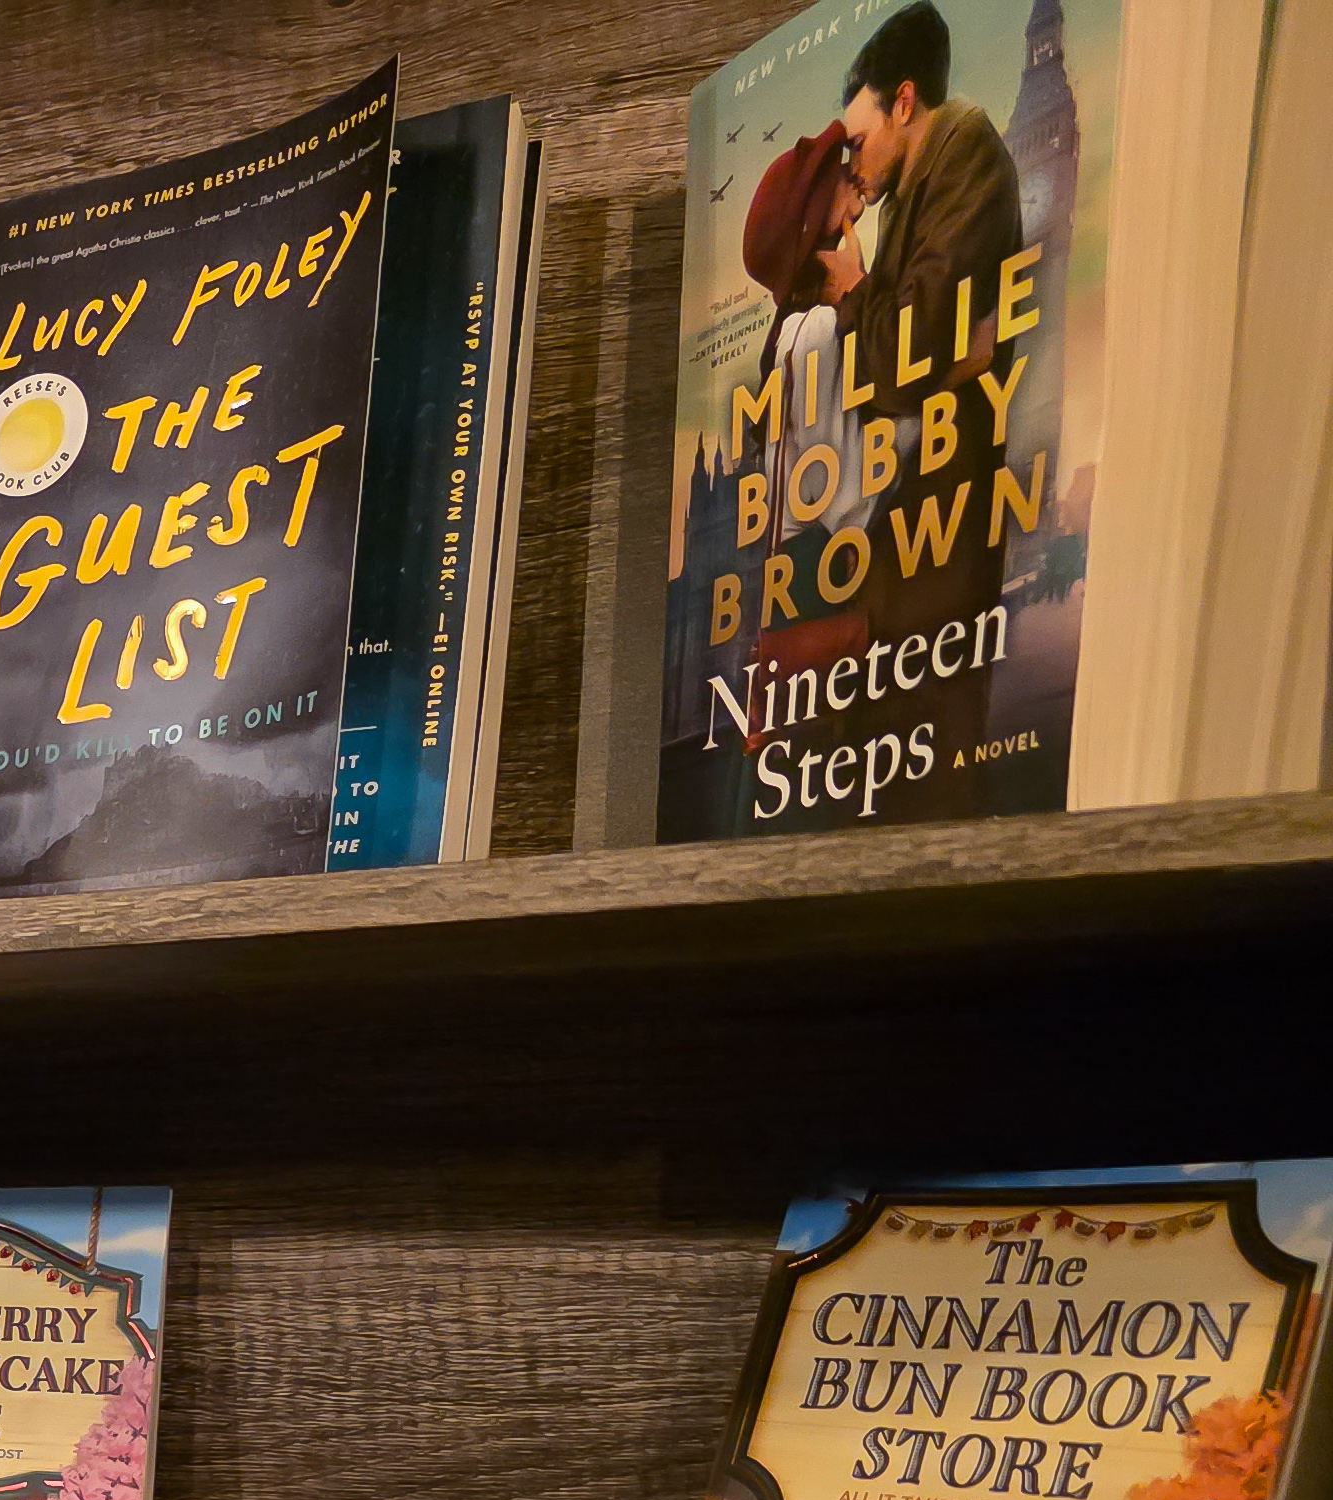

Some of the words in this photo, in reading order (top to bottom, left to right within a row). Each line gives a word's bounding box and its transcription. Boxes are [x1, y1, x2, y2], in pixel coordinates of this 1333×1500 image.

[8, 223, 29, 240] #1
[36, 210, 74, 232] NEW
[85, 198, 135, 224] YORK
[143, 182, 195, 207] TIMES
[203, 135, 320, 191] BESTSELLING
[327, 93, 388, 144] AUTHOR
[172, 190, 371, 346] FOLEY
[1, 378, 68, 408] REESE'S
[461, 364, 476, 387] AT
[733, 242, 1043, 462] MILLIE
[103, 365, 264, 473] THE
[454, 399, 473, 458] YOUR
[739, 356, 1028, 550] BOBBY
[33, 450, 72, 488] CLUB
[447, 470, 466, 521] OWN
[710, 452, 1046, 647] BROWN
[56, 578, 267, 725] LIST
[702, 605, 1010, 751] Nineteen
[148, 724, 183, 746] TO
[199, 715, 229, 739] BE
[244, 702, 283, 729] ON
[296, 691, 318, 717] IT
[423, 664, 445, 747] ONLINE
[753, 724, 936, 820] Steps
[954, 749, 967, 769] A
[976, 731, 1040, 764] NOVEL
[984, 1238, 1089, 1289] The
[810, 1292, 1250, 1361] CINNAMON
[799, 1357, 962, 1417] BUN
[973, 1364, 1214, 1438] BOOK
[851, 1427, 1103, 1500] STORE
